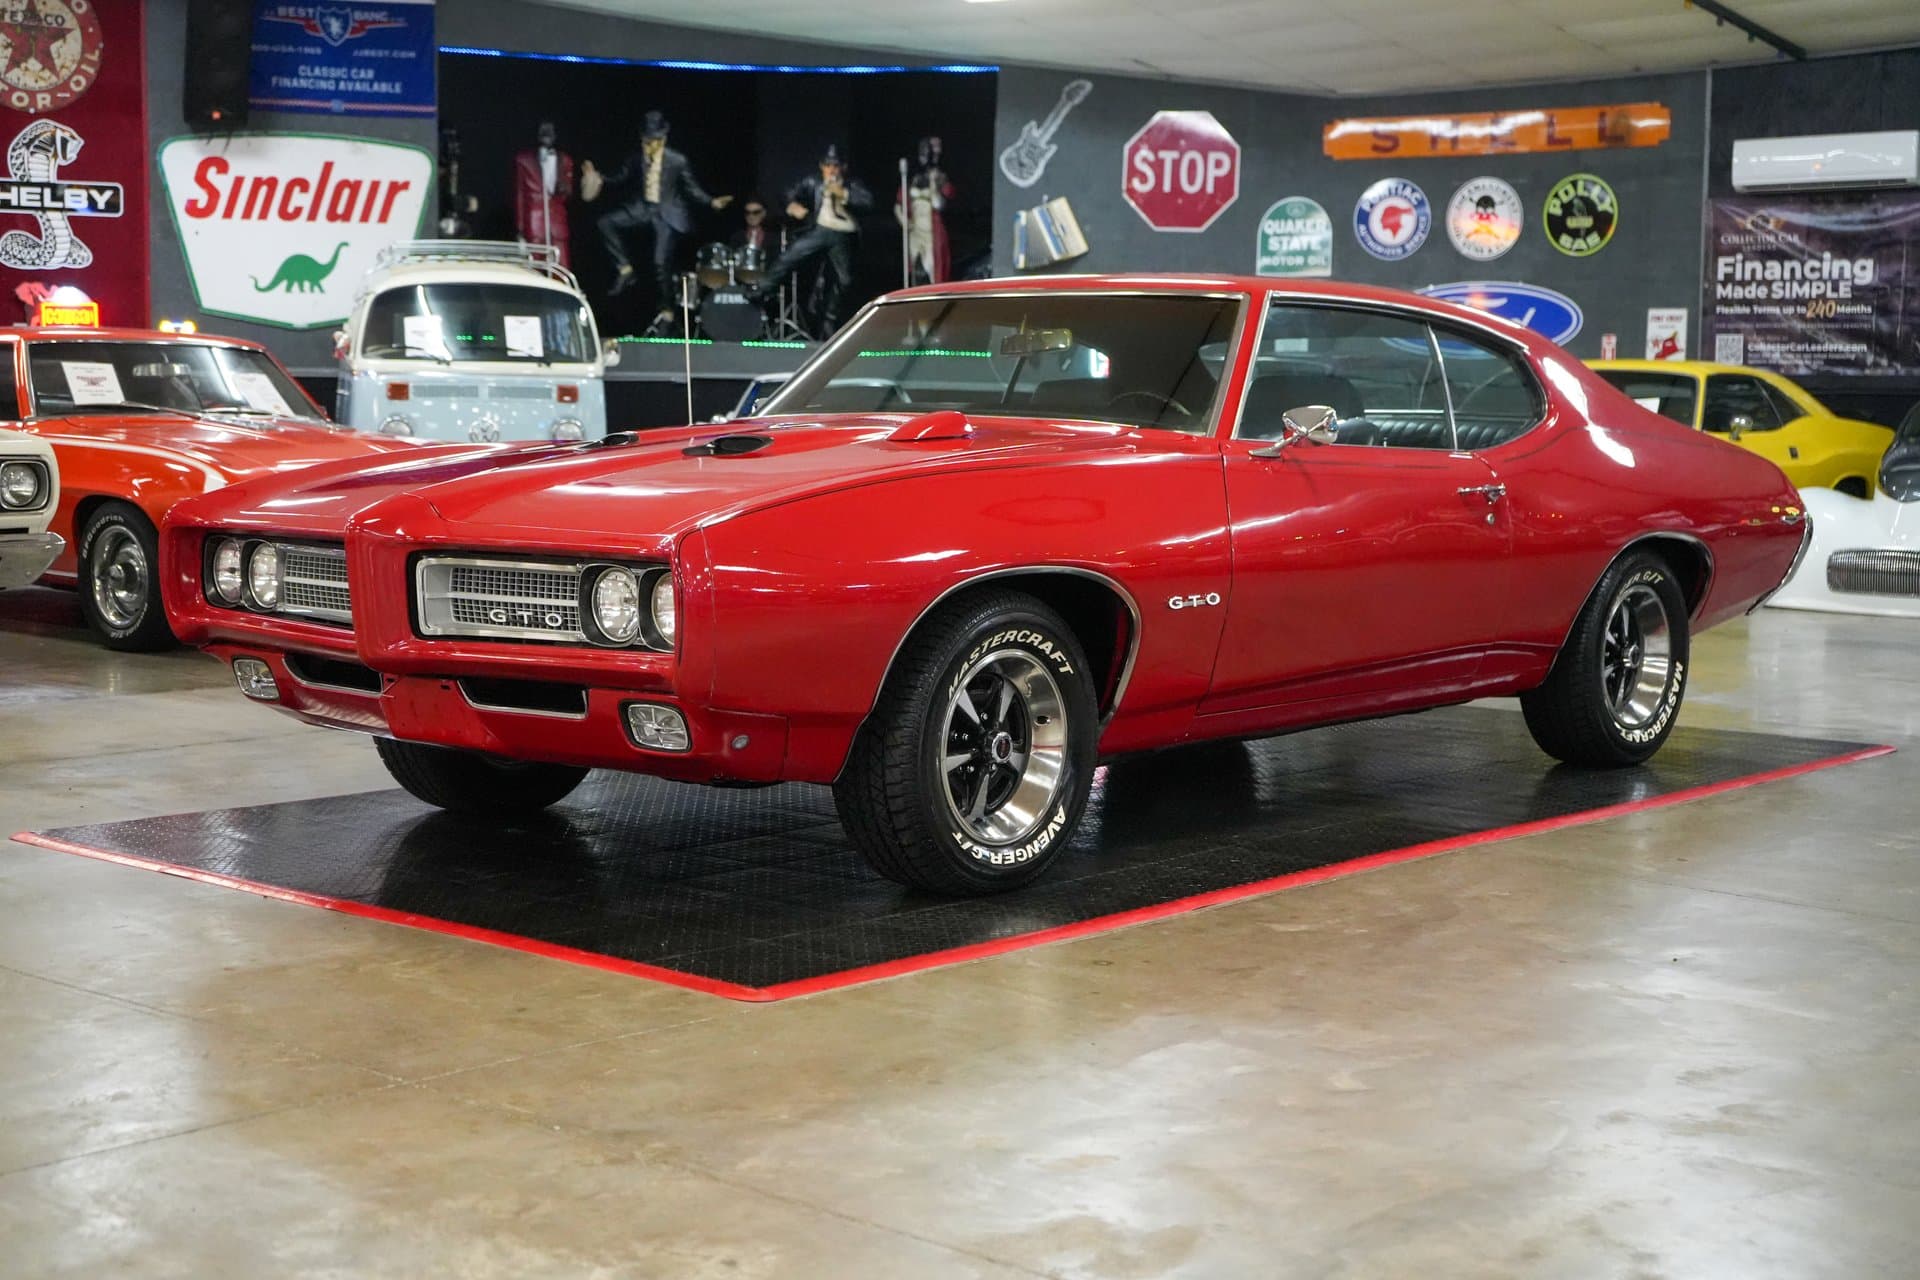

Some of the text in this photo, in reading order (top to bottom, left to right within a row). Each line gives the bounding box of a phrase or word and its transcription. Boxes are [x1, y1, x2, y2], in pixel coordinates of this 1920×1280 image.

[0, 8, 65, 26] TECO
[277, 6, 314, 17] BEST
[298, 65, 375, 79] CLASSIC CAR
[271, 76, 402, 94] FINANCING AVAILABLE
[1372, 111, 1624, 152] SHELL
[1131, 147, 1232, 194] STOP
[0, 185, 114, 210] HELBY
[184, 155, 410, 224] Sinclair
[1360, 182, 1421, 212] PTIAC
[1549, 180, 1614, 216] POLLY
[1264, 219, 1328, 234] QUAKER
[1268, 235, 1321, 251] STATE
[1559, 231, 1600, 250] GAS
[1261, 255, 1327, 266] MOTOR OIL
[1717, 252, 1874, 285] Financing
[1716, 281, 1852, 299] Made SIMPLE
[1716, 300, 1873, 318] Flexible Terms up to 240 Months
[1168, 592, 1221, 609] GTO
[489, 608, 563, 627] GTO
[948, 629, 1074, 700] MASTERCRAFT
[1619, 660, 1684, 743] MASTERCRAFT
[952, 804, 1067, 866] AVENGER G/T
